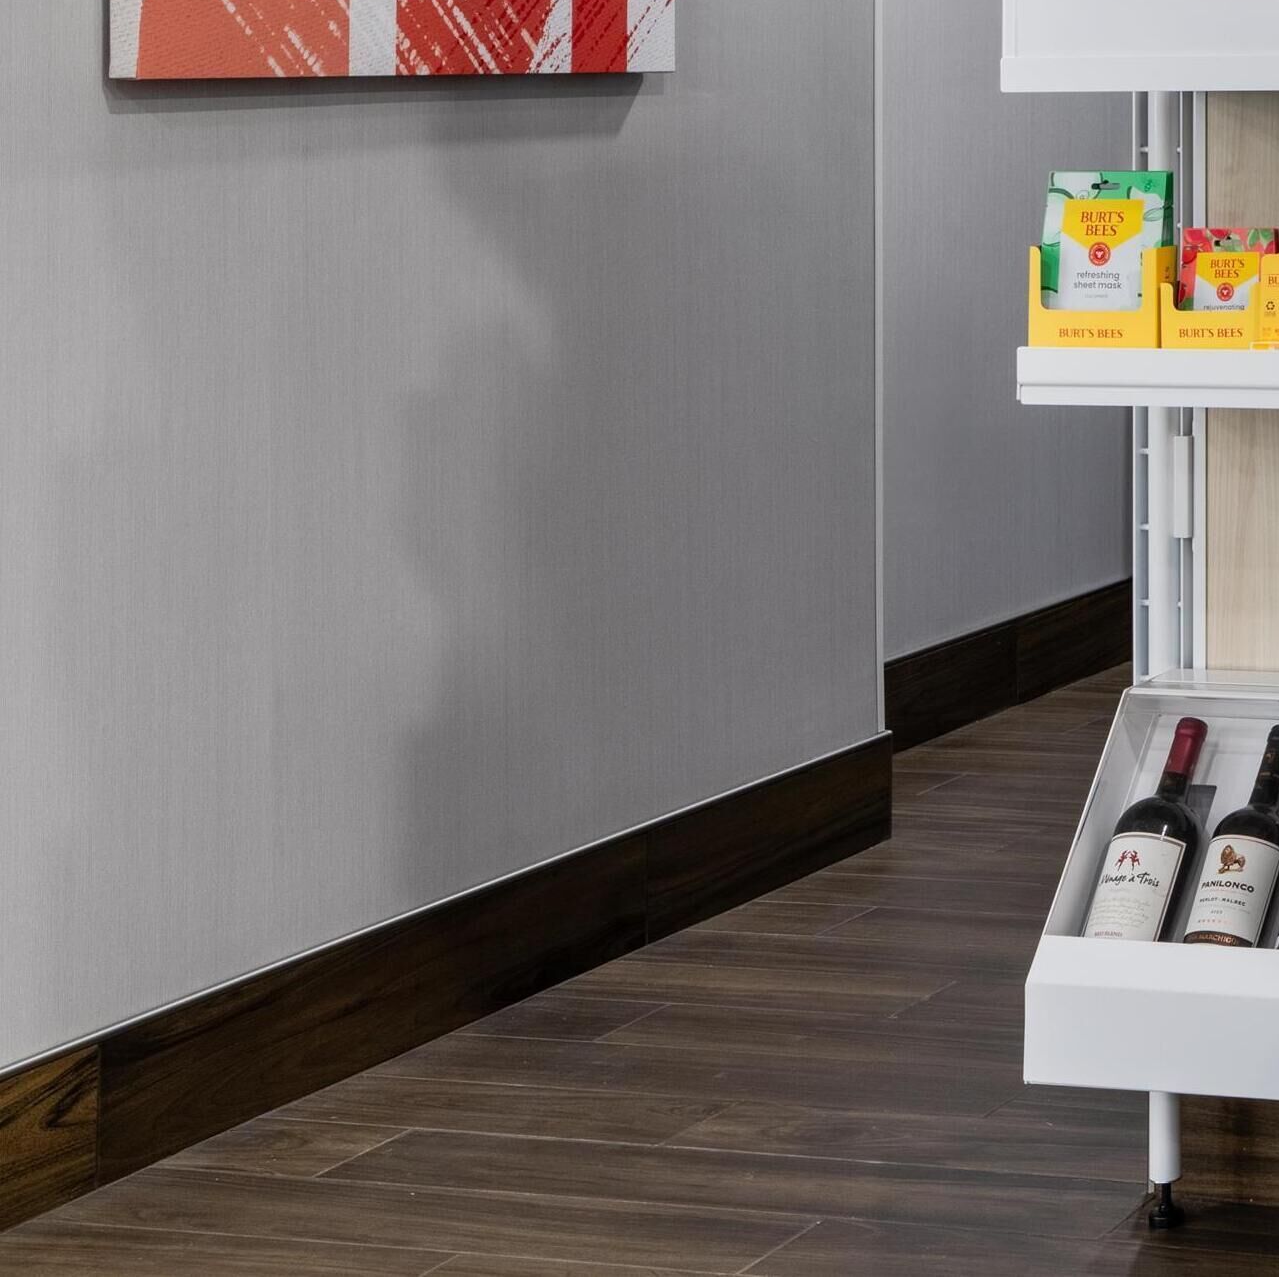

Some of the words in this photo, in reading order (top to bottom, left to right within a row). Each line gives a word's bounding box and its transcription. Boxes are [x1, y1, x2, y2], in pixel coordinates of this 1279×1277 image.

[1080, 211, 1124, 223] BURT'S
[1085, 225, 1117, 236] BEES
[1076, 270, 1120, 281] refreshing
[1073, 280, 1096, 290] sheet
[1098, 281, 1122, 290] mask
[1137, 872, 1159, 888] Trois
[1201, 881, 1255, 893] PANILONCO
